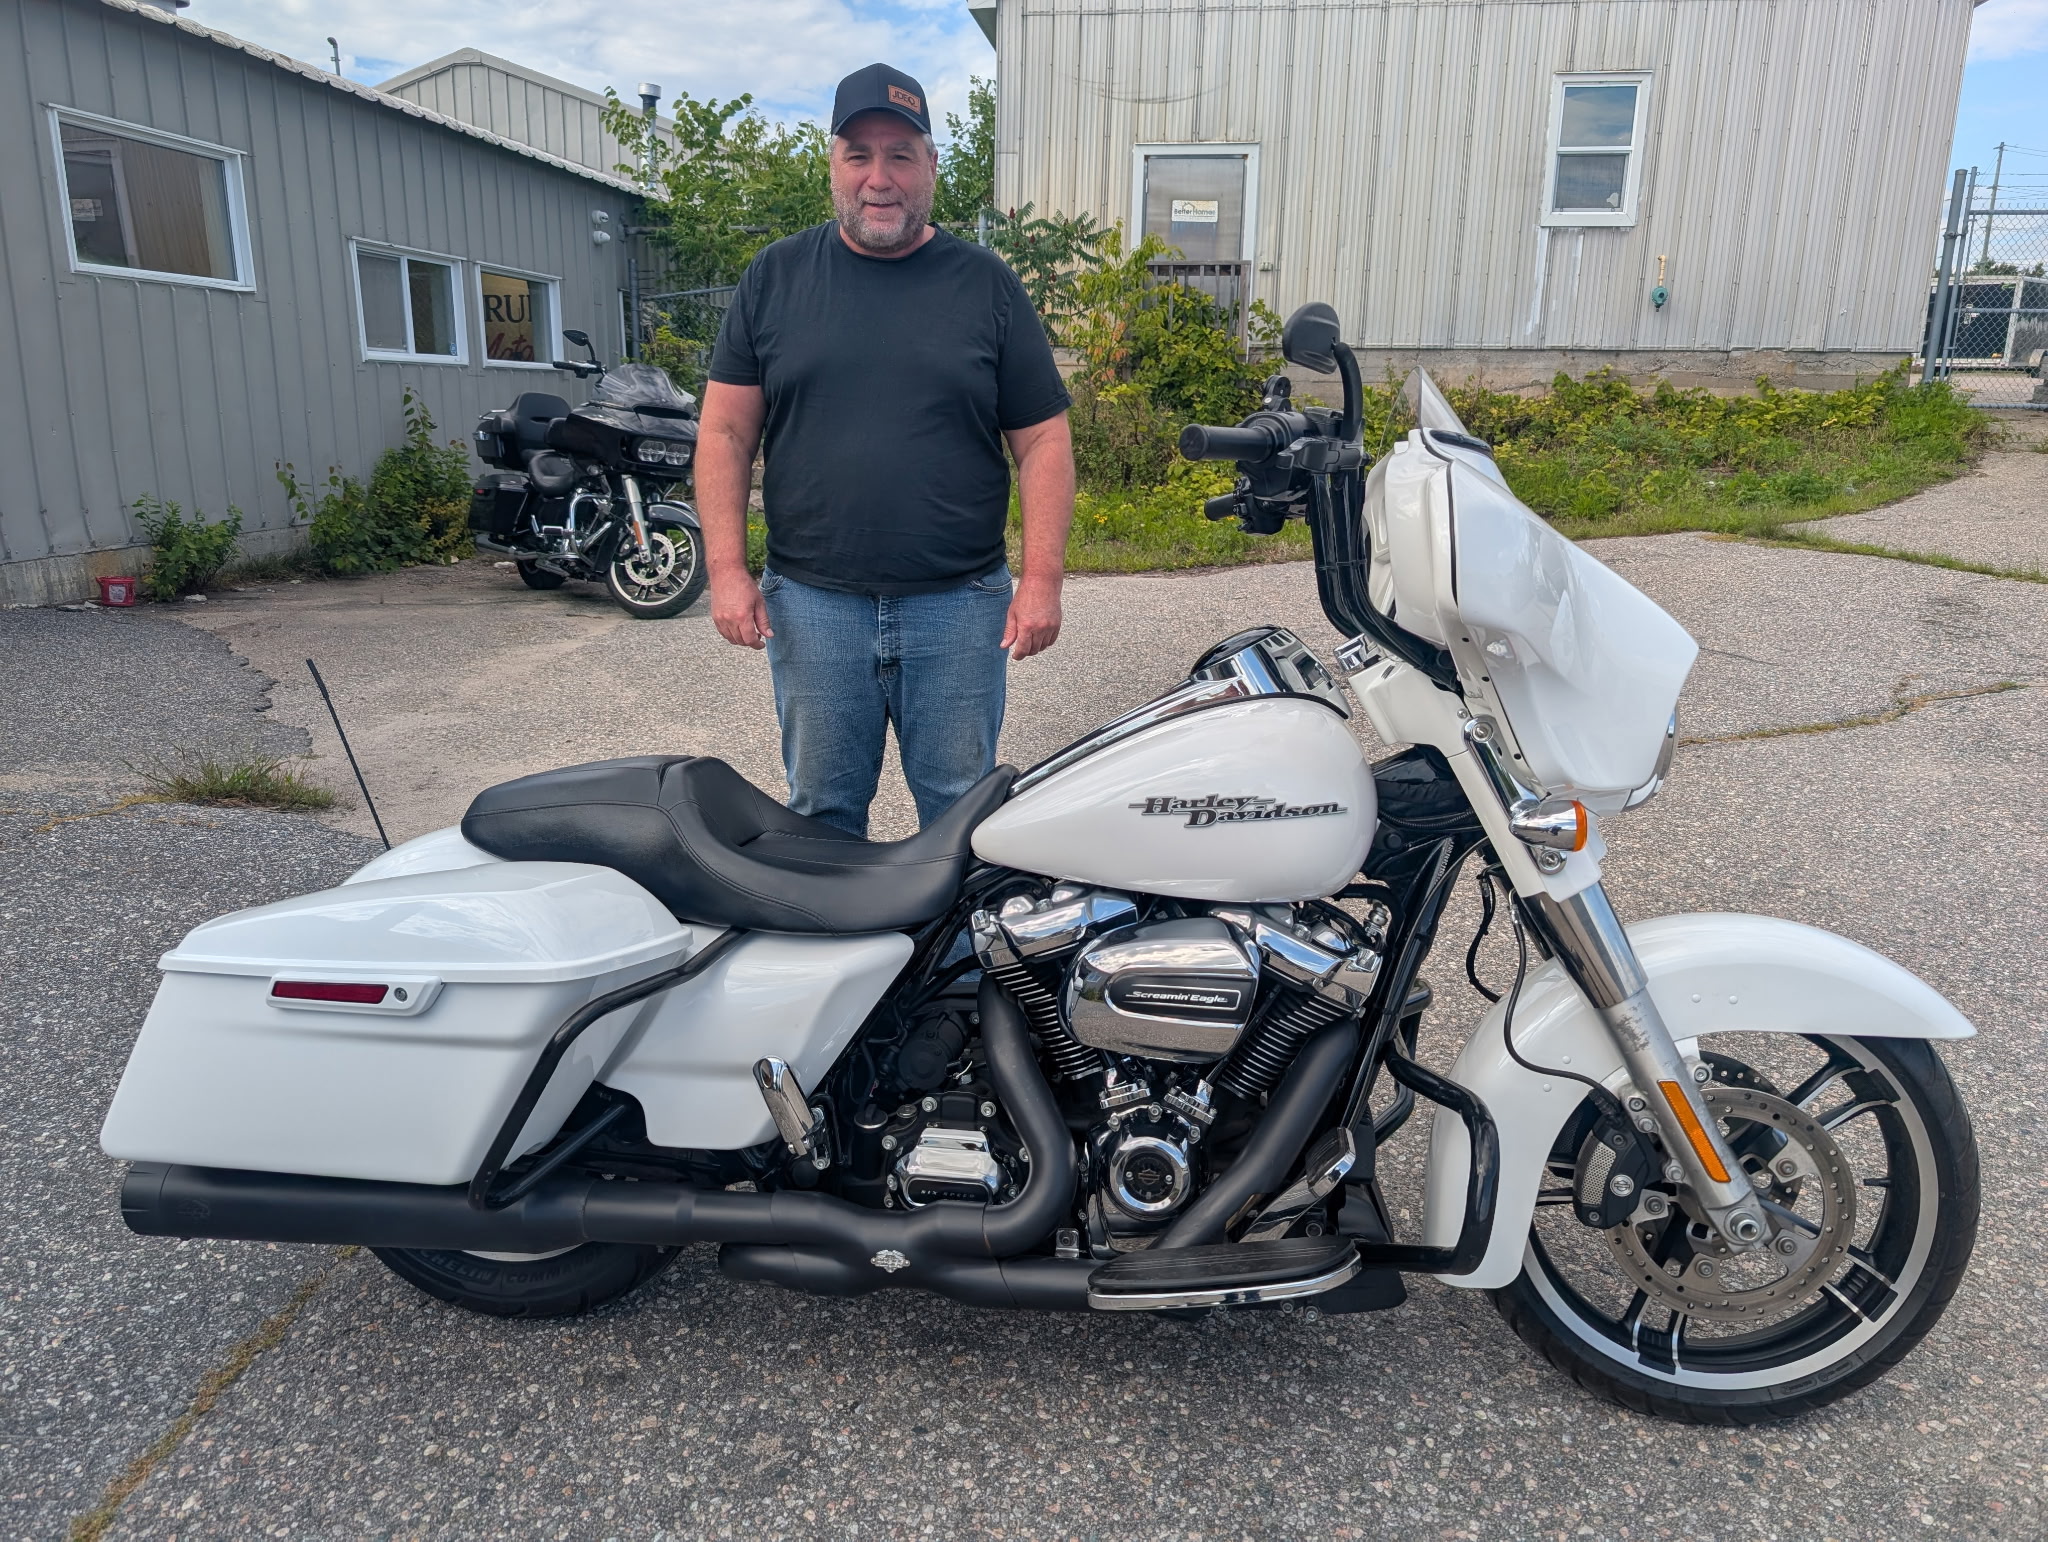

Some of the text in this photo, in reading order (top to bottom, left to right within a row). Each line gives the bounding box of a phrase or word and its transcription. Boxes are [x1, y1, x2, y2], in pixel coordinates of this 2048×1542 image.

[1132, 793, 1272, 816] Harley
[1183, 801, 1346, 828] Davidson
[1127, 990, 1228, 1004] Screamin' Eagle
